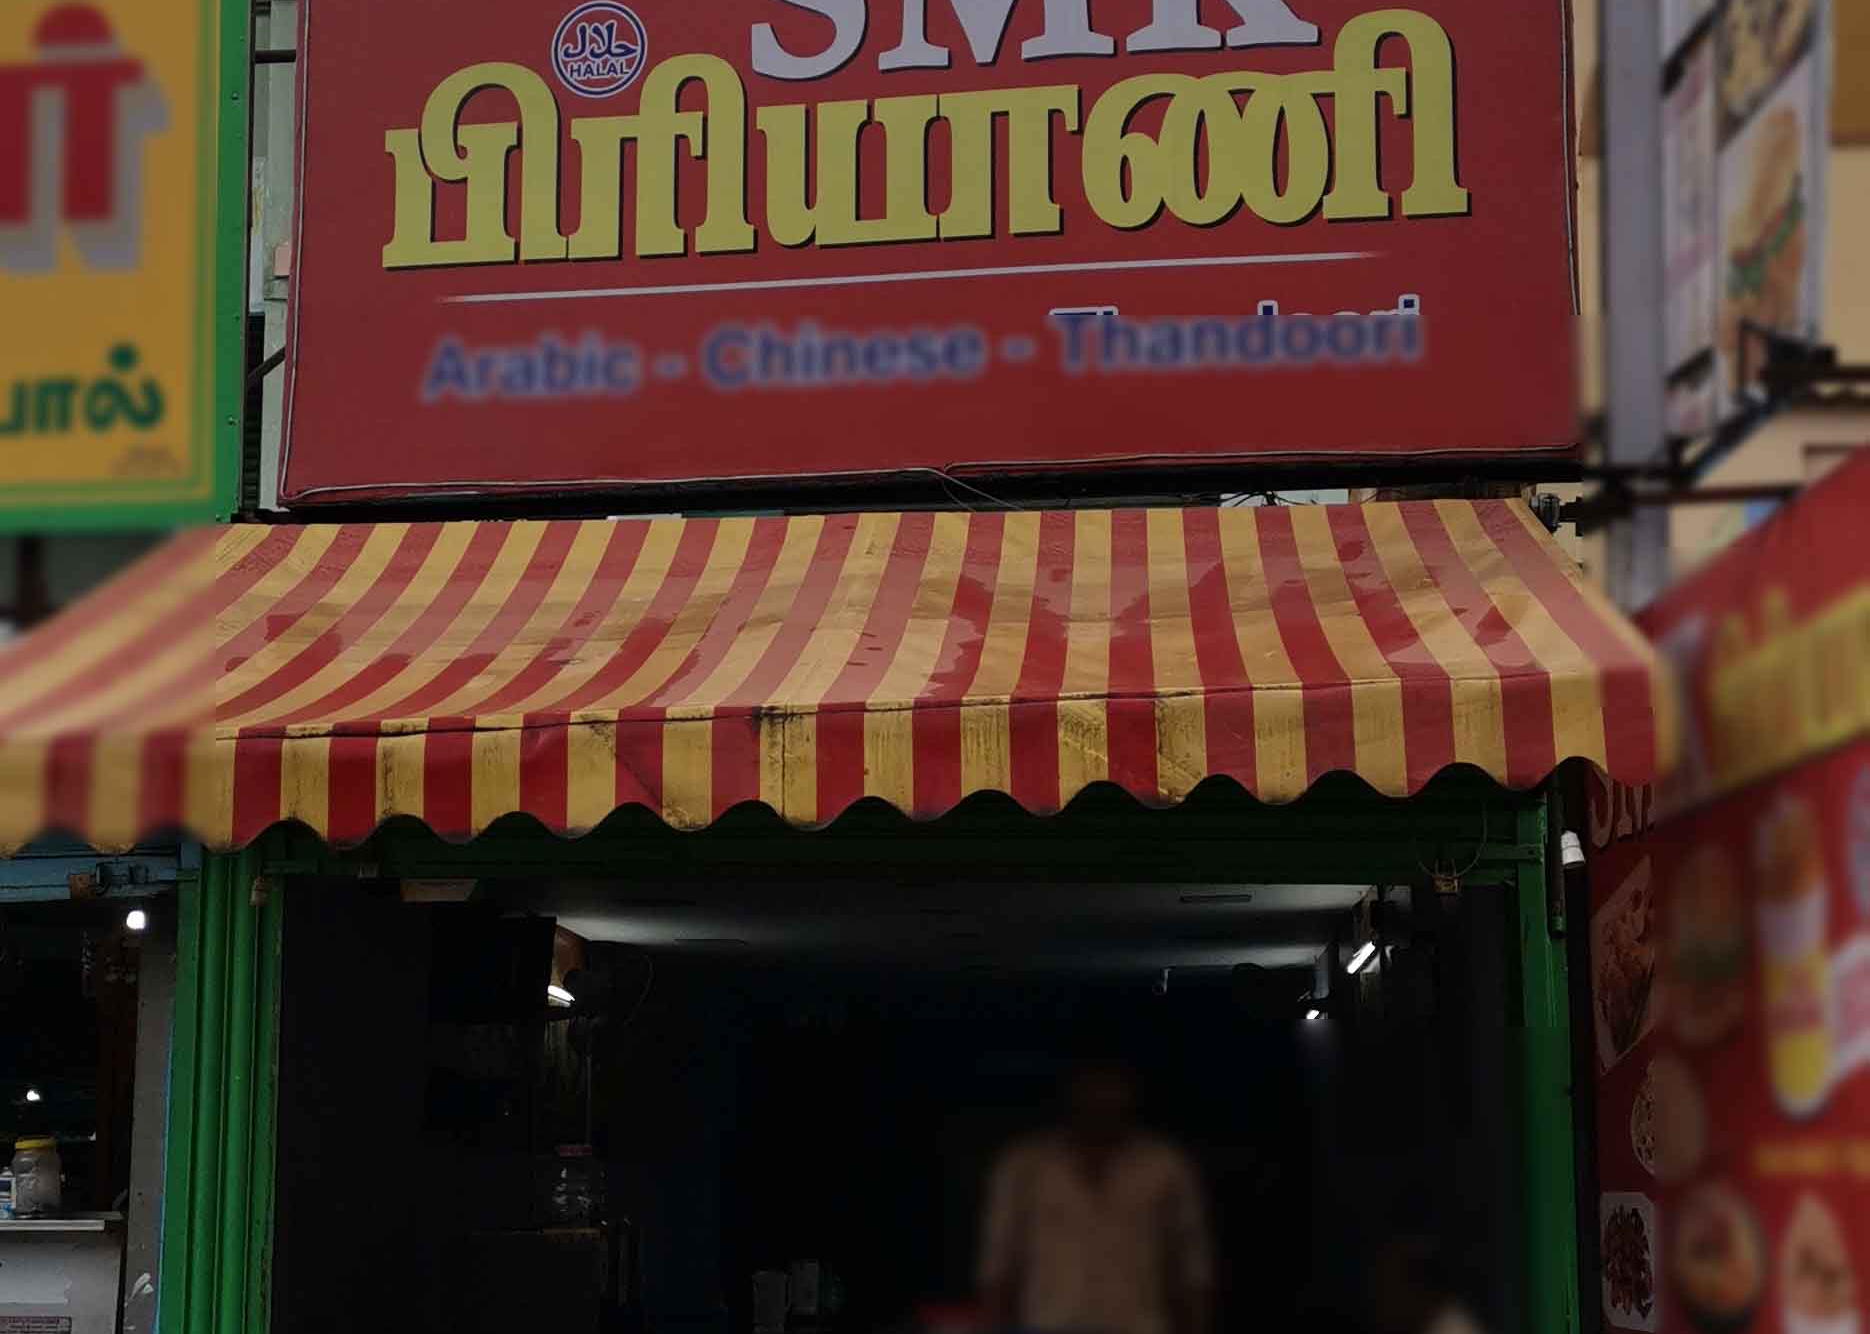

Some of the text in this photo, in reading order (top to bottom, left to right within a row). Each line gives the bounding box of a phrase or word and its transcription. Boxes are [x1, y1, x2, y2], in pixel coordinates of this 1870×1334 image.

[562, 19, 640, 59] حلال
[569, 59, 631, 78] HALAL
[383, 8, 1470, 269] பிரியாணி
[424, 331, 638, 403] Arabic
[702, 324, 984, 389] Chinese
[1048, 293, 1421, 373] Thandoori
